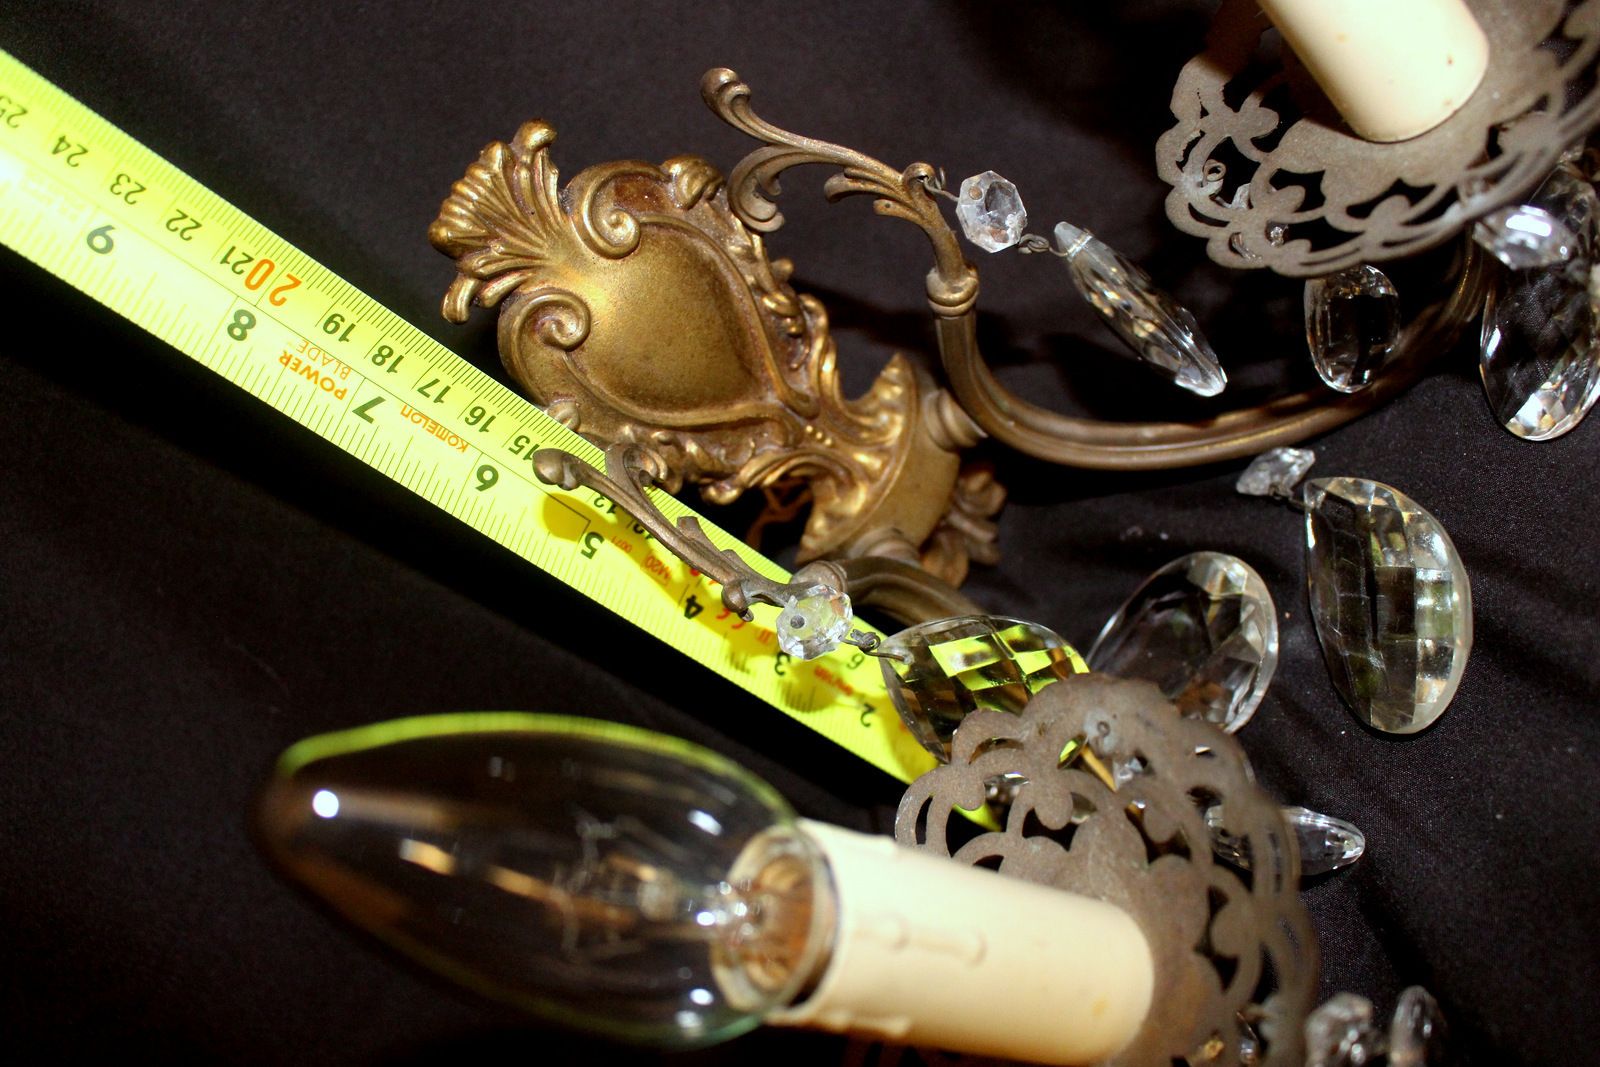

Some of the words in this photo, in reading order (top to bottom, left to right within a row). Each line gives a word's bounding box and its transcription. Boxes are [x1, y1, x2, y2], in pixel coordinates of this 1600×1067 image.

[51, 135, 88, 167] 24
[110, 173, 146, 205] 23
[86, 225, 115, 254] 9
[165, 209, 202, 241] 22
[220, 246, 254, 275] 21
[244, 258, 302, 306] 20
[227, 309, 256, 341] 8
[322, 313, 356, 343] 19
[296, 340, 351, 380] BLADE
[371, 345, 405, 374] 18
[278, 350, 348, 400] POWER
[417, 378, 451, 404] 17
[352, 396, 386, 424] 7
[464, 406, 496, 433] 16
[508, 435, 540, 461] 15
[475, 464, 499, 492] 6
[580, 531, 605, 560] 5
[684, 594, 704, 620] 4
[774, 651, 792, 676] 3
[859, 703, 876, 728] 2
